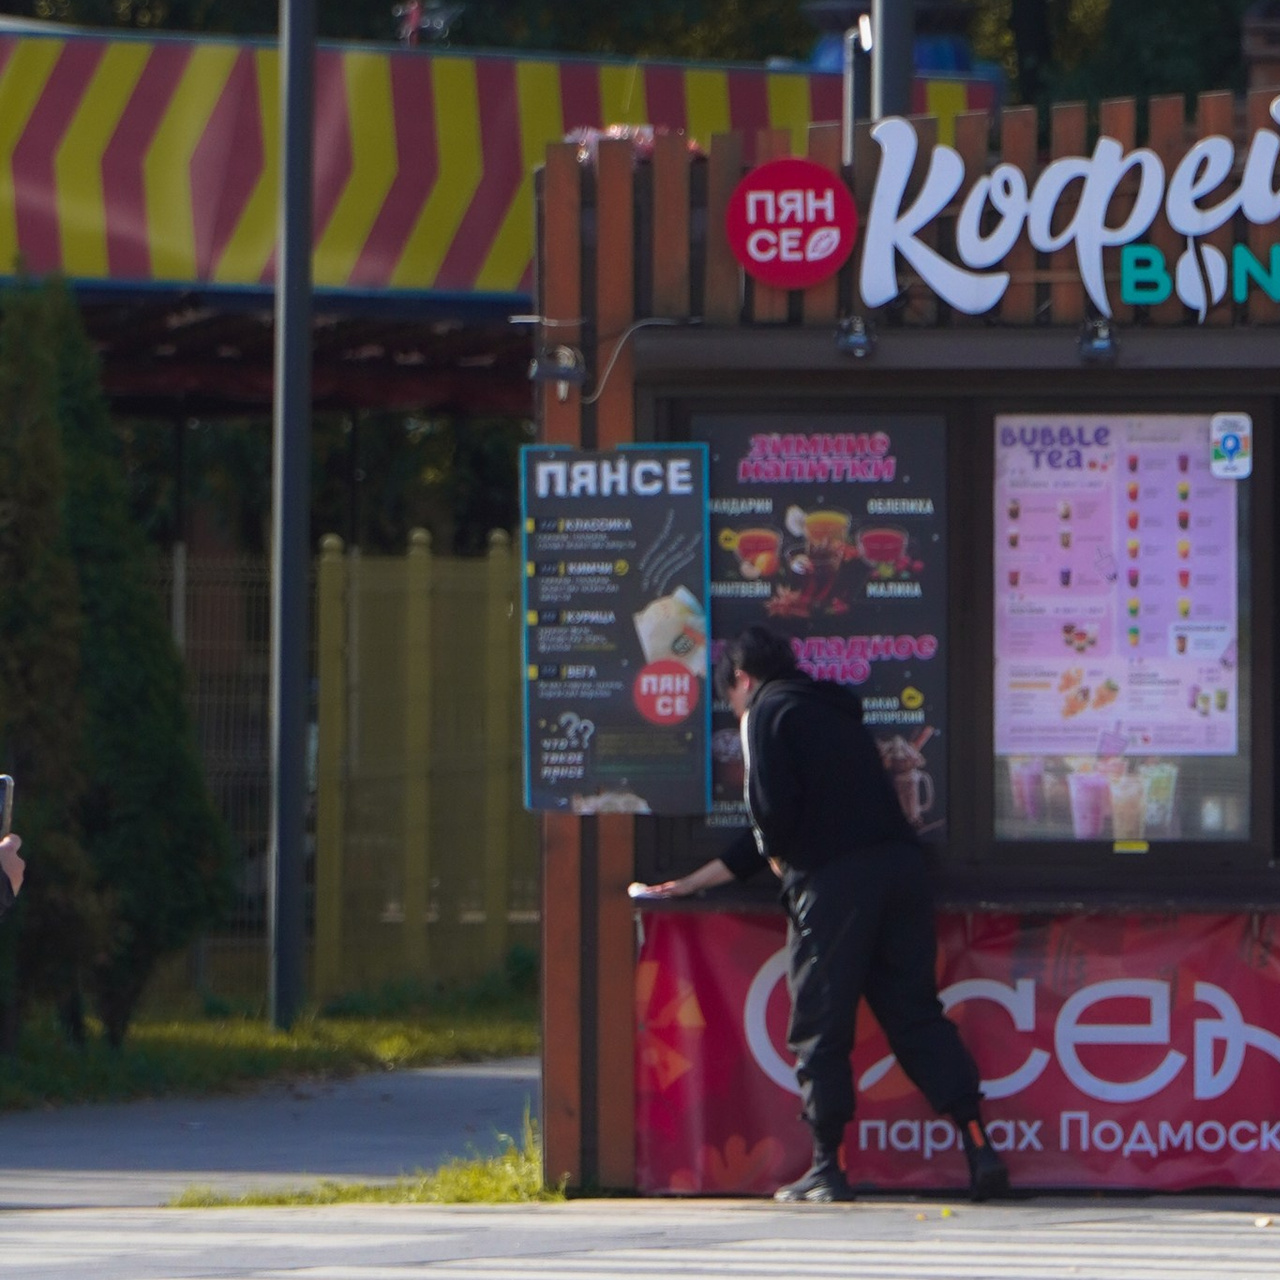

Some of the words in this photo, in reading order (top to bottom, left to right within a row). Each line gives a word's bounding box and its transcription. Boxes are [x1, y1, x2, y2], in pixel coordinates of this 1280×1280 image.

[745, 190, 836, 226] ПЯН
[746, 228, 803, 262] СЕ
[1001, 425, 1111, 447] BUBBLE
[535, 458, 694, 499] ПЯНСЕ
[866, 581, 922, 598] МАЛИНА
[641, 673, 691, 695] ПЯН
[656, 695, 689, 716] СЕ
[858, 1119, 1042, 1160] парах
